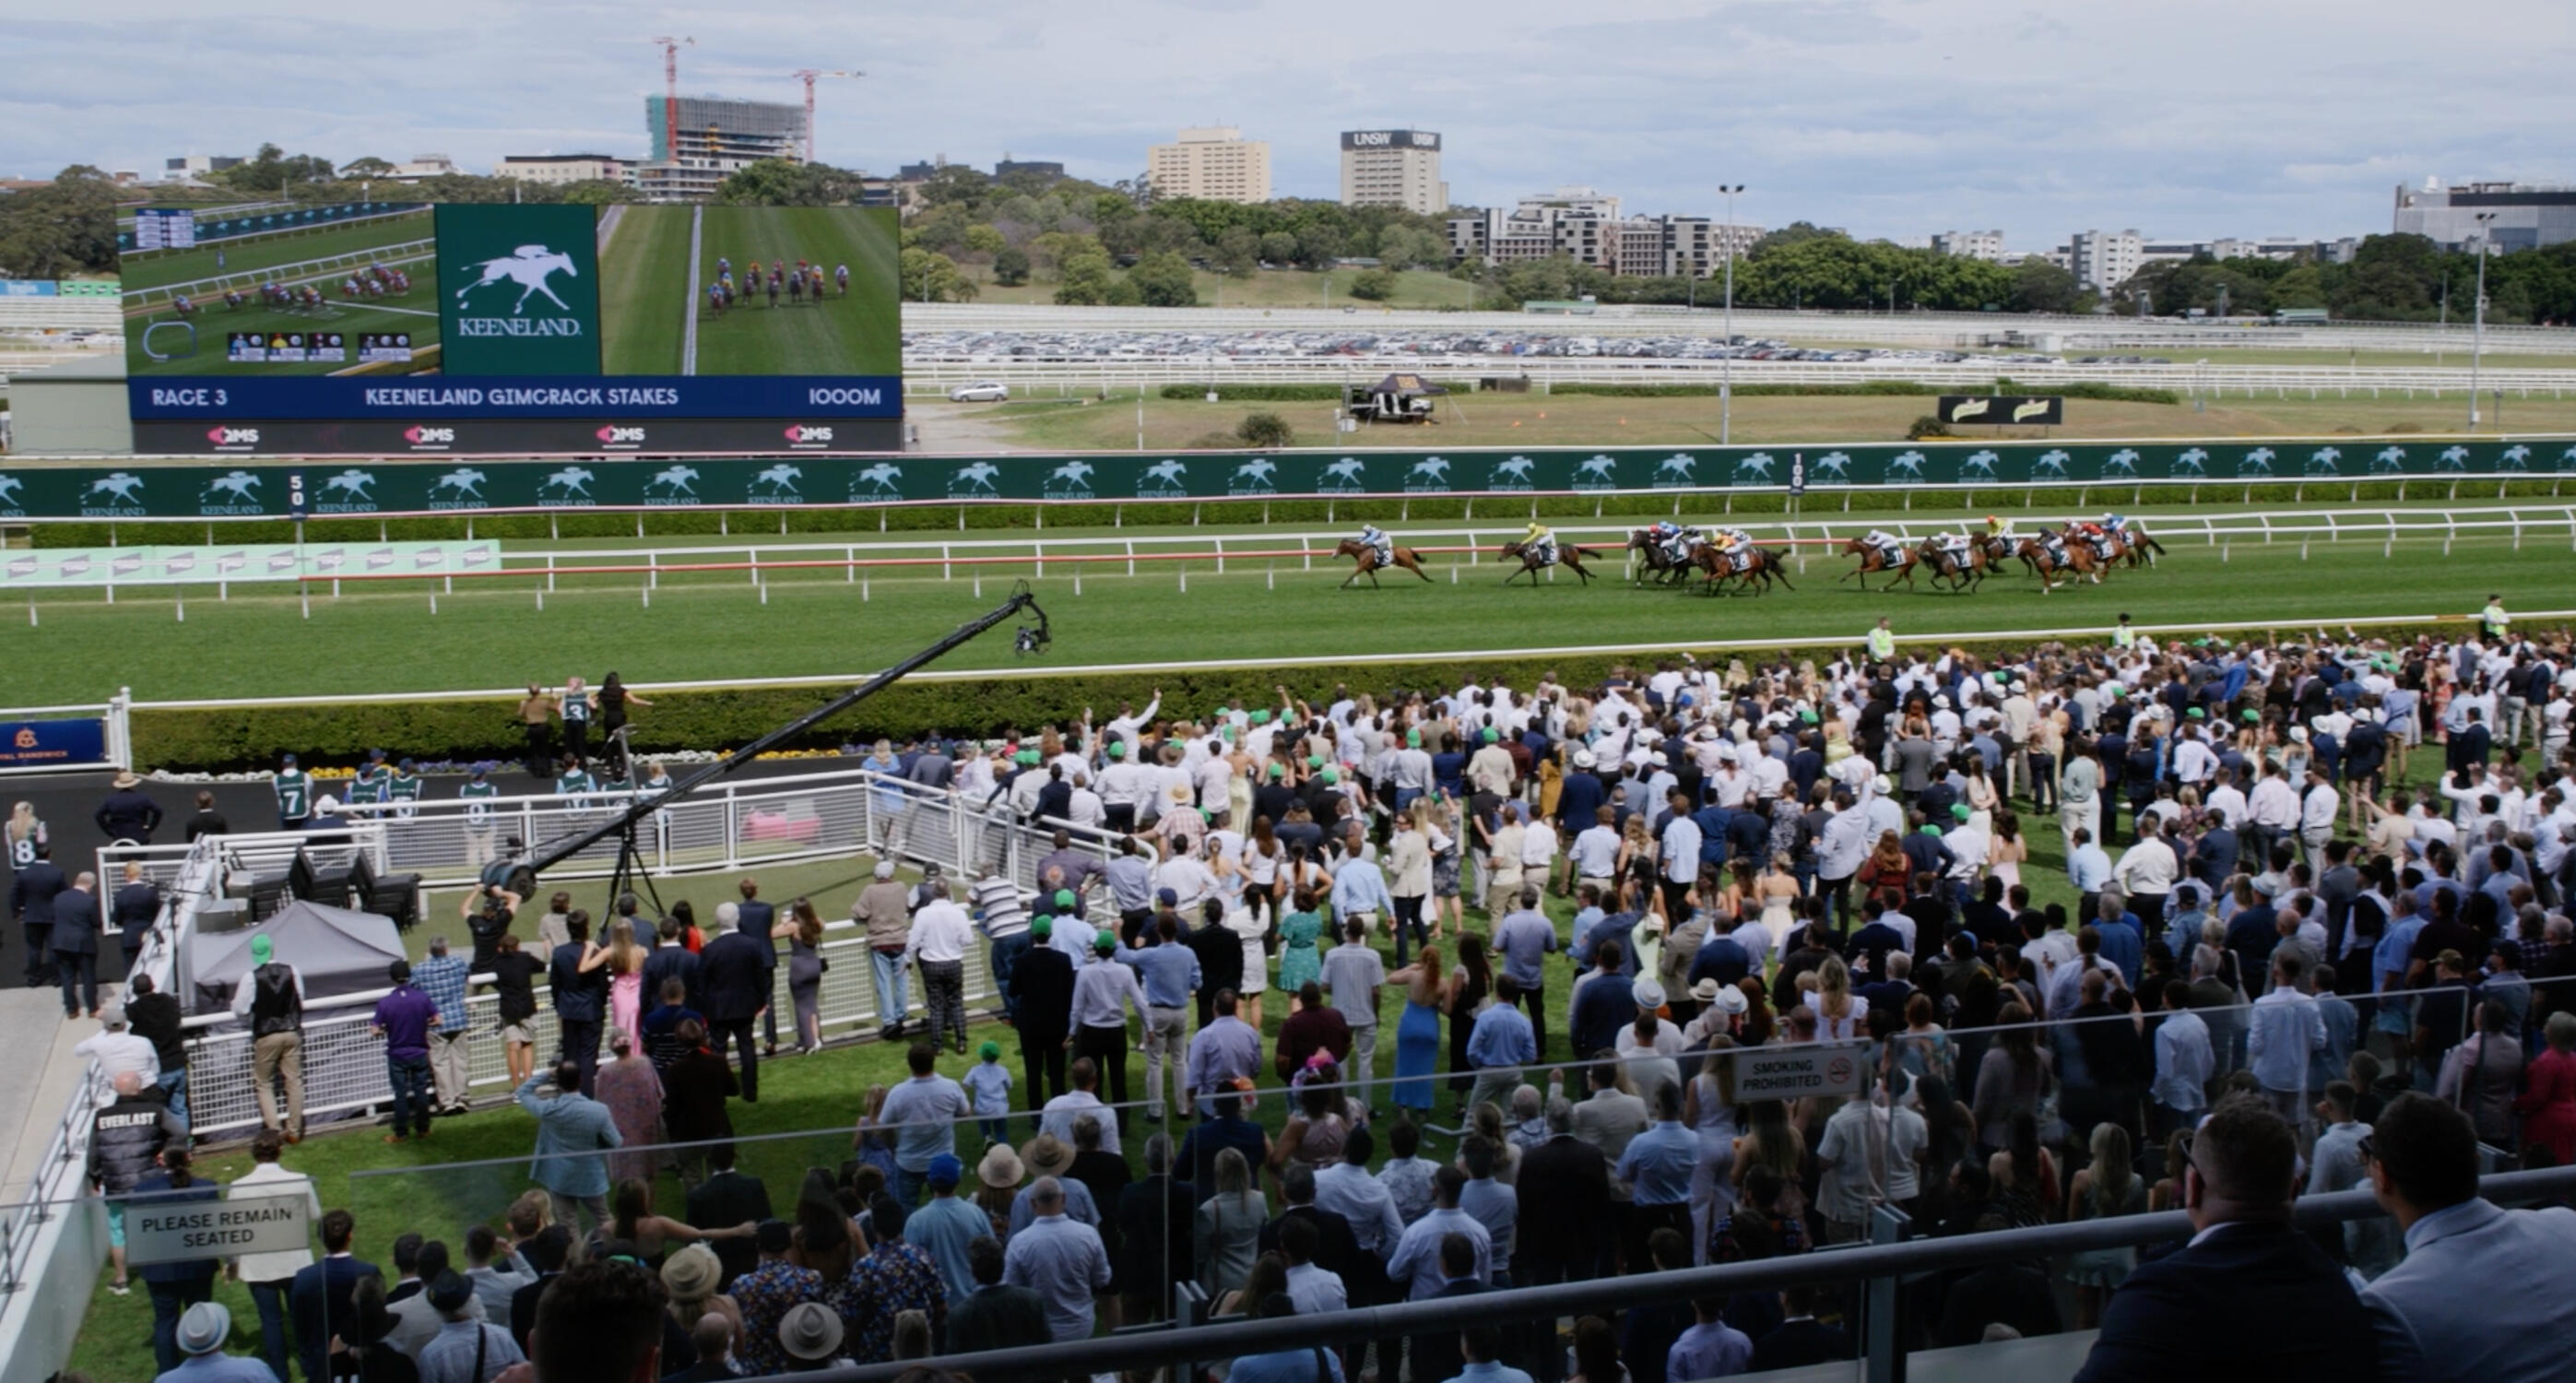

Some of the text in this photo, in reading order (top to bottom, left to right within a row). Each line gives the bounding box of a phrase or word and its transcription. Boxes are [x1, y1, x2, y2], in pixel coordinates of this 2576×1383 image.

[1353, 132, 1392, 146] UNSW
[458, 317, 581, 336] KEENELAND
[152, 388, 228, 406] RACE 3
[365, 388, 679, 406] KEENELAND GIMCRACK STAKES
[809, 388, 881, 405] 1000M
[200, 505, 264, 515] KEENELAND
[283, 790, 301, 814] 7
[15, 839, 36, 864] 8
[1753, 1059, 1814, 1075] SMOKING
[1743, 1074, 1823, 1091] PROHIBITED
[99, 1112, 156, 1130] EVERLAST
[141, 1208, 292, 1233] PLEASE REMAIN
[183, 1229, 254, 1248] SEATED
